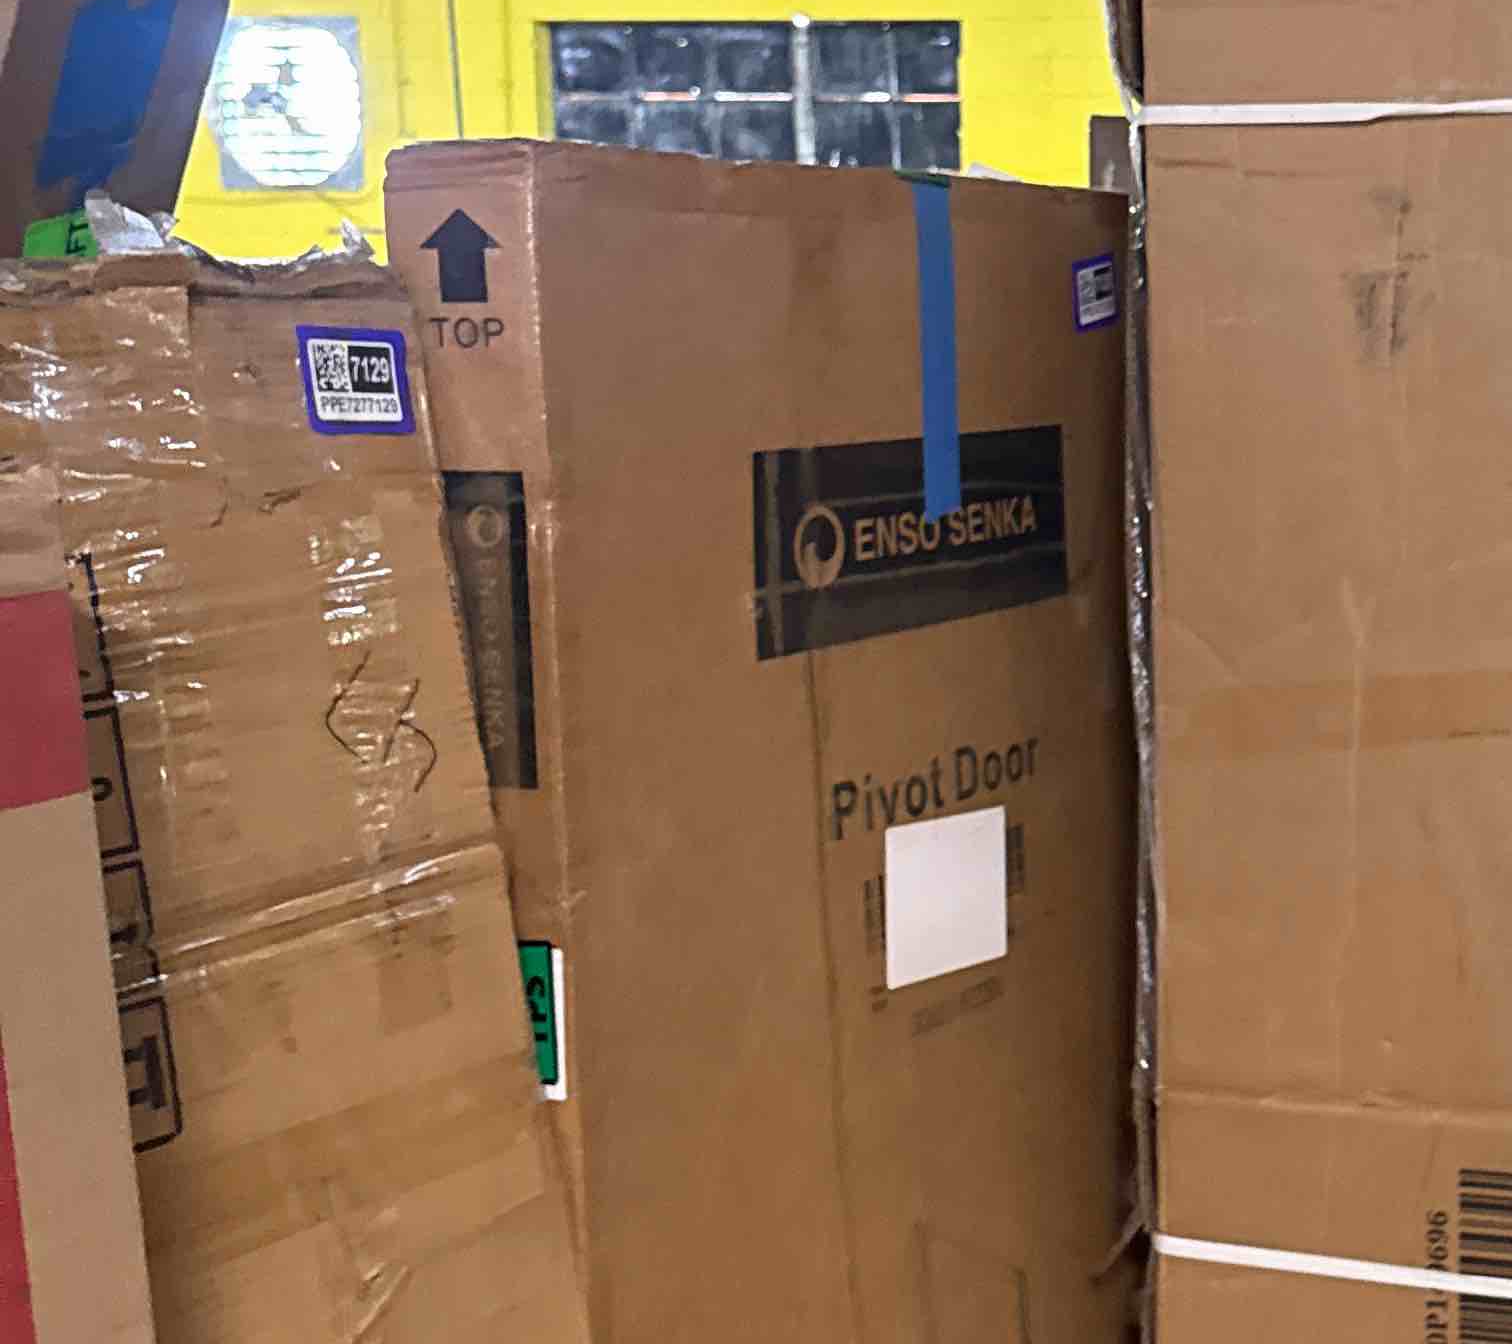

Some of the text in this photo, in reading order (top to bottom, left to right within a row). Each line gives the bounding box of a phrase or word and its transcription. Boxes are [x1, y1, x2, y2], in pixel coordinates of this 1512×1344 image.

[428, 316, 505, 349] TOP
[349, 355, 390, 384] 7129
[854, 495, 1038, 563] ENSO SENKA
[831, 736, 1039, 842] Pivot Door
